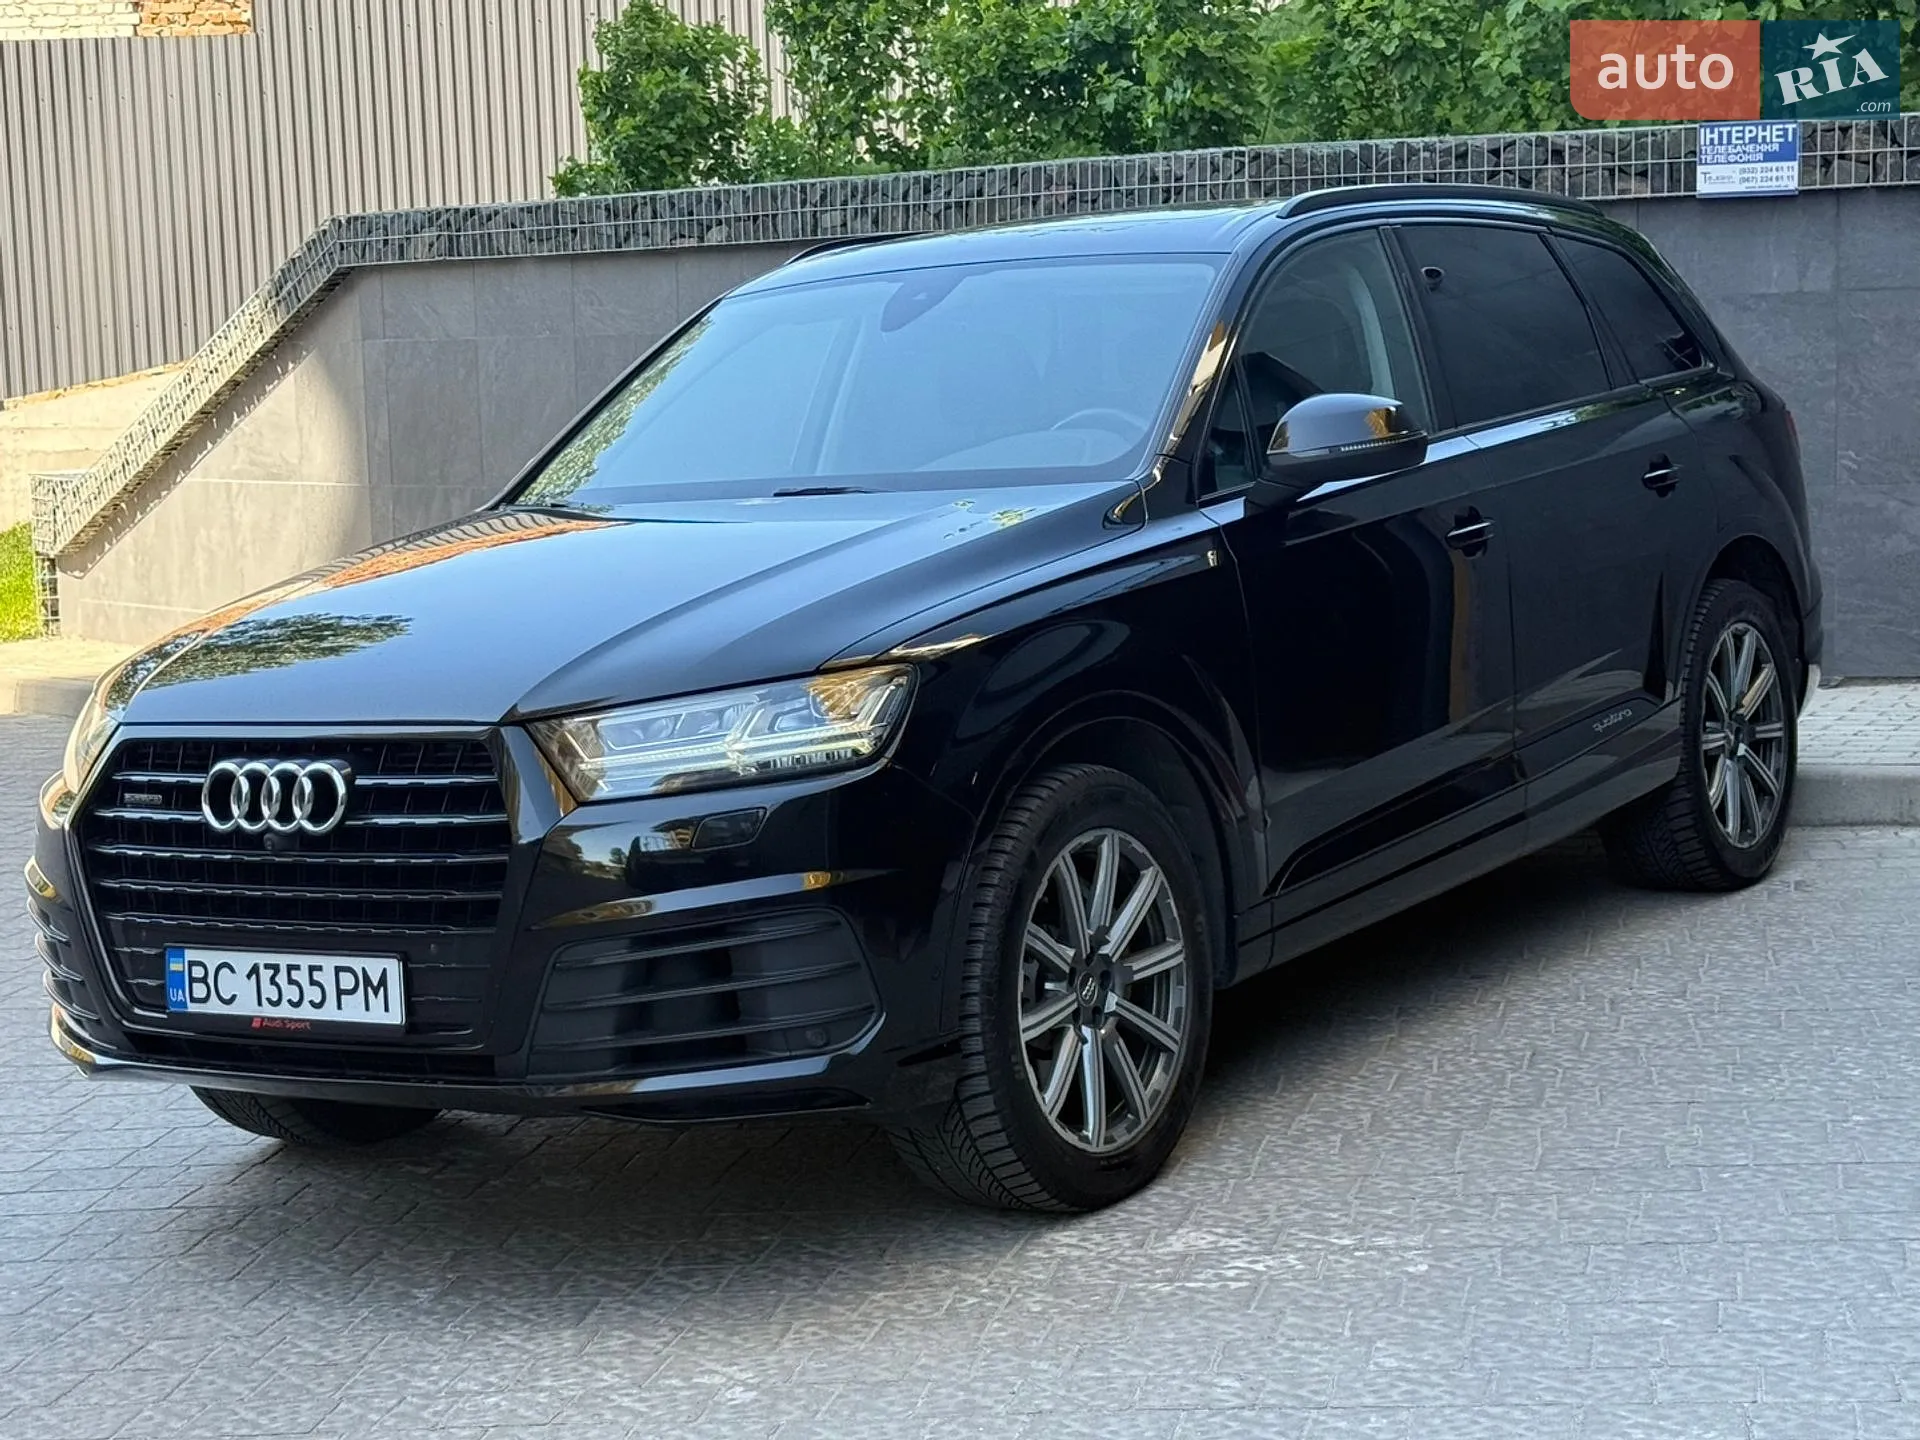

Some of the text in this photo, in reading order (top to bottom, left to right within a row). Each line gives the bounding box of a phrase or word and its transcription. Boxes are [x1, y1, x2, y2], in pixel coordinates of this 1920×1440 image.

[1700, 124, 1797, 145] ІНТЕРНЕТ
[1701, 143, 1780, 155] ТЕЛЕБАЧЕННЯ
[1701, 153, 1764, 164] ТЕЛЕФОНІЯ
[169, 988, 185, 1002] UA
